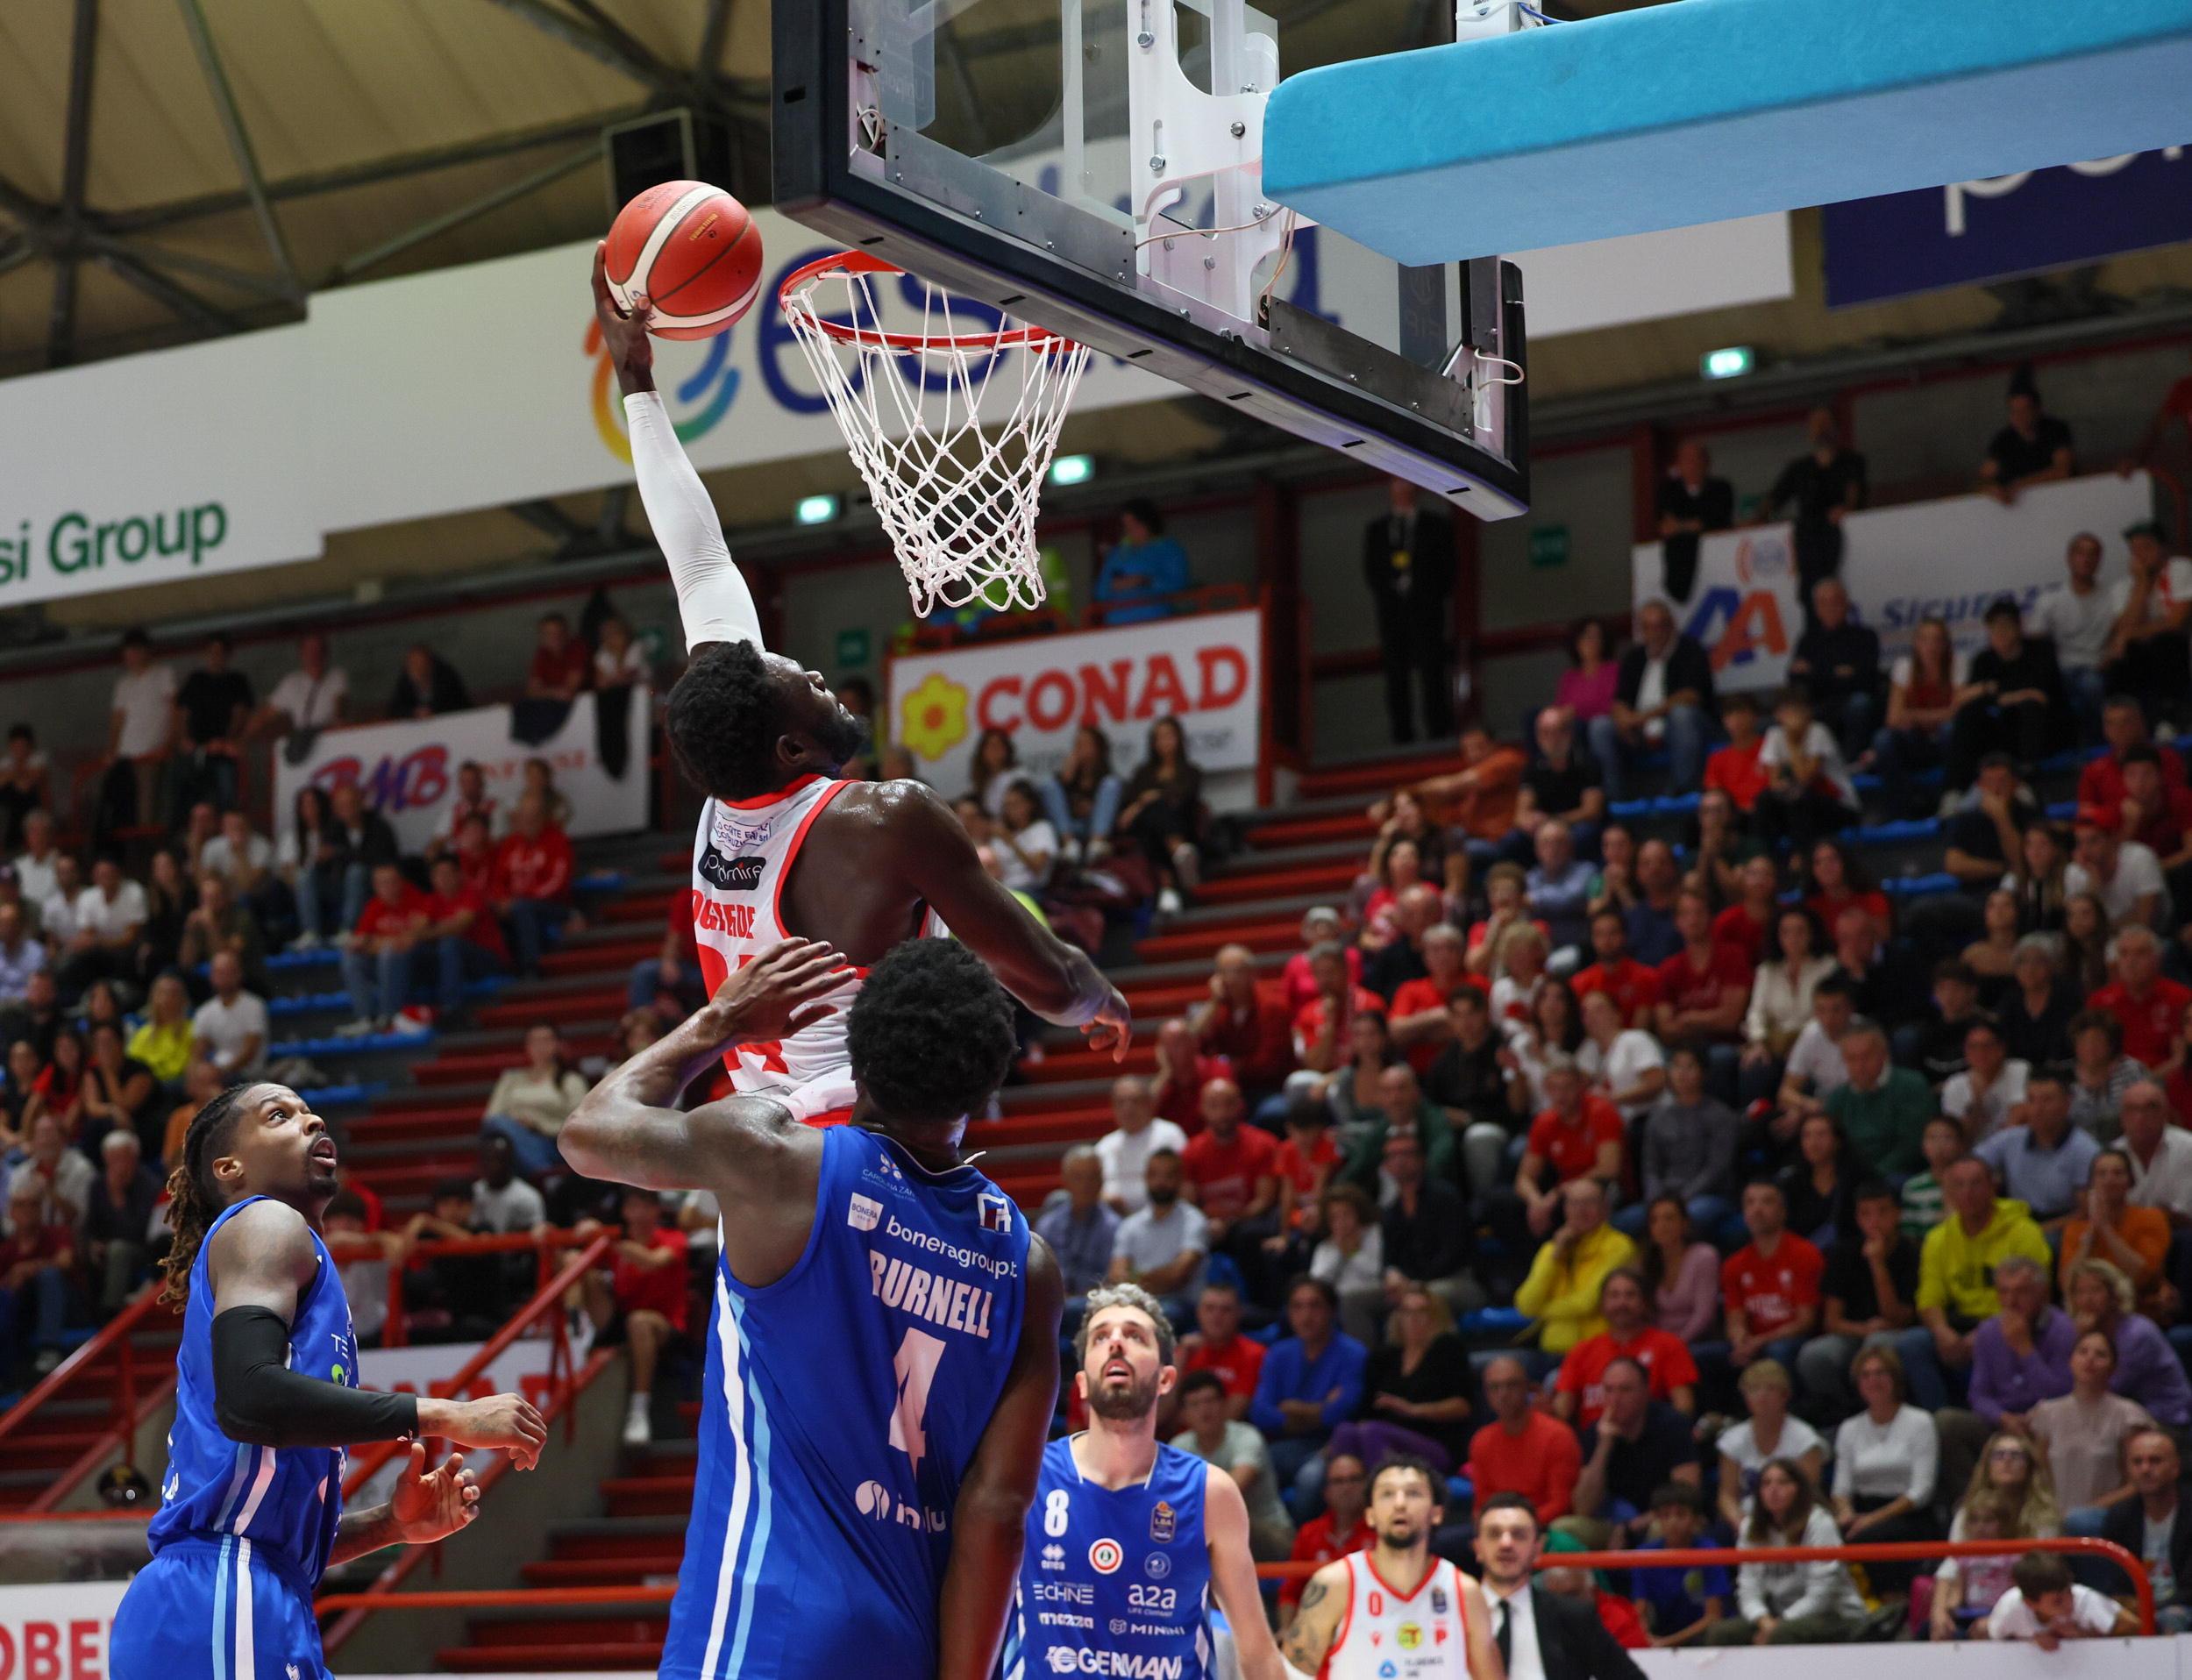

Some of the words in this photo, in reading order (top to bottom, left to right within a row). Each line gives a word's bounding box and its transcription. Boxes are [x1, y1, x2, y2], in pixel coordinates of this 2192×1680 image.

[49, 502, 227, 574] Group
[977, 645, 1248, 737] CONAD
[889, 1327, 947, 1480] 4
[1043, 1489, 1070, 1538] 8
[1128, 1584, 1177, 1609] a2a
[1368, 1591, 1383, 1617] 0
